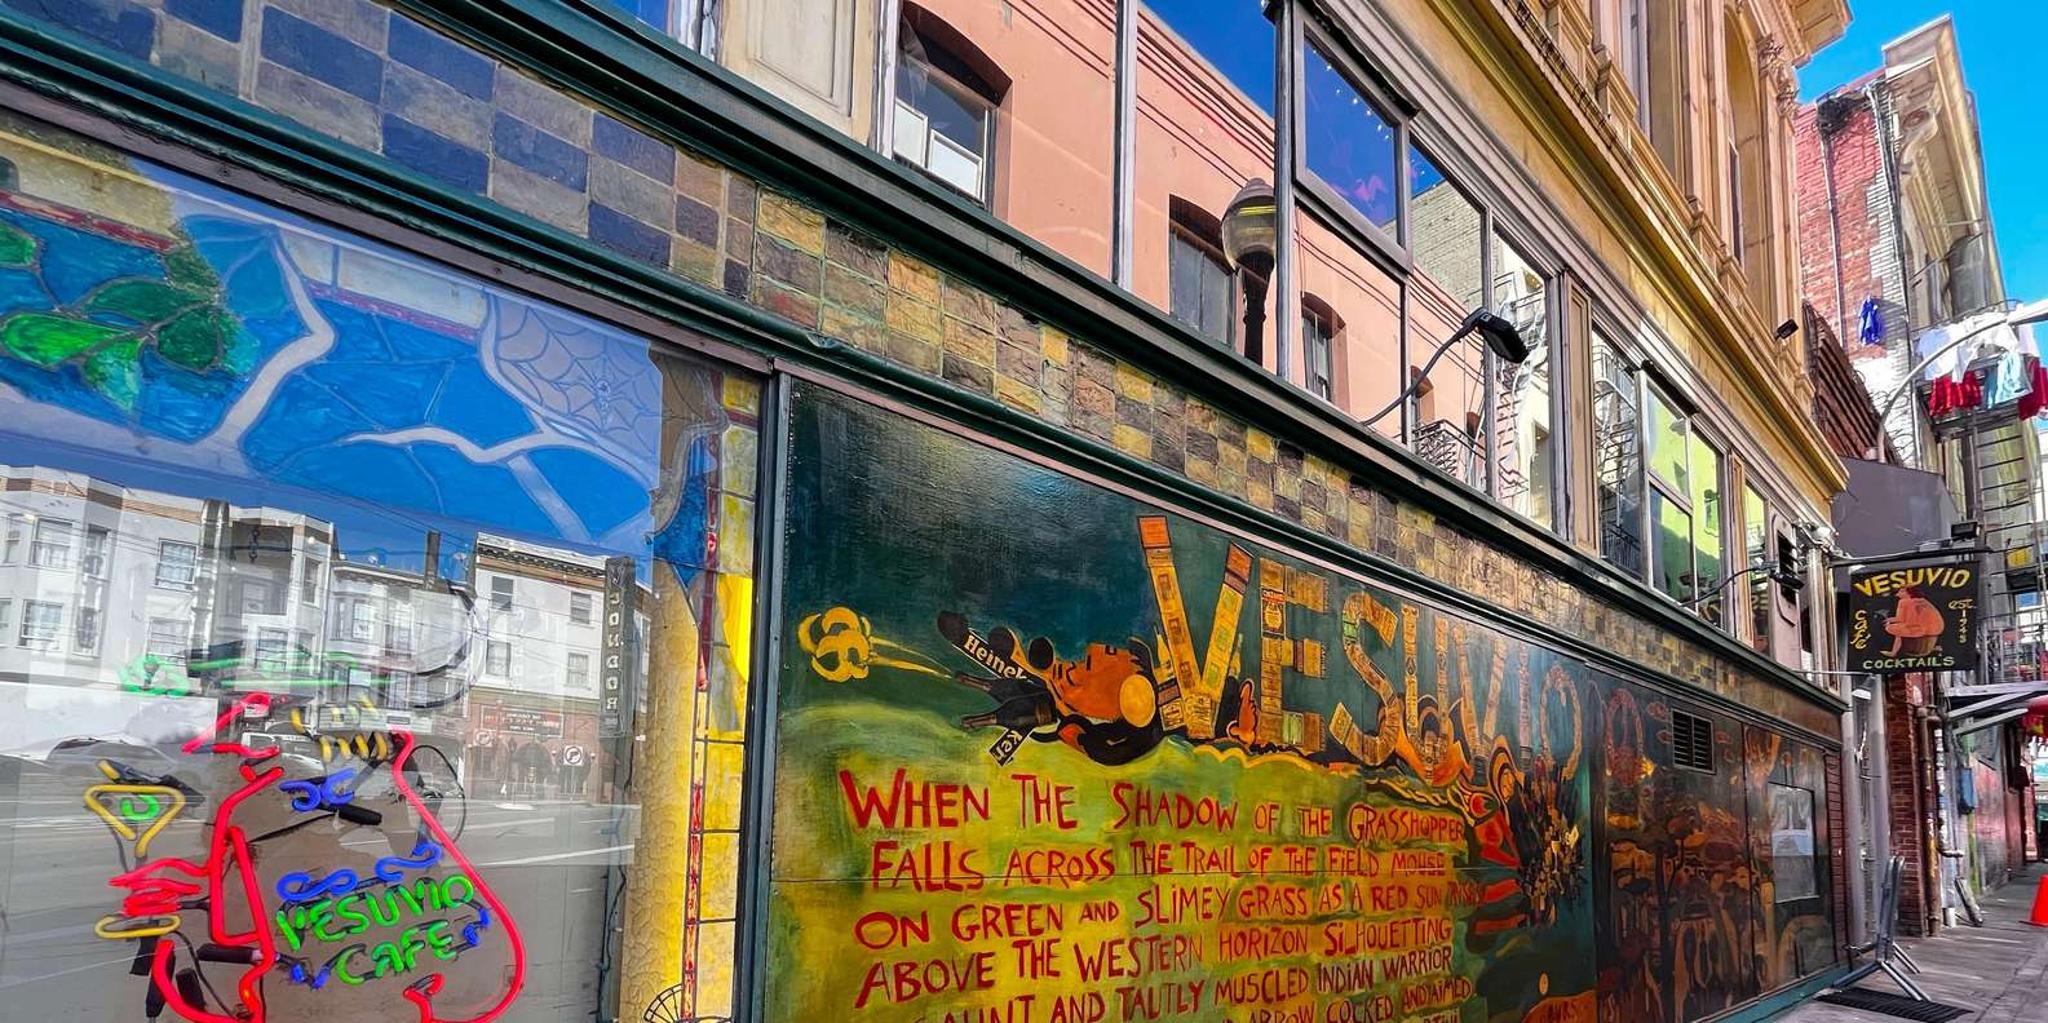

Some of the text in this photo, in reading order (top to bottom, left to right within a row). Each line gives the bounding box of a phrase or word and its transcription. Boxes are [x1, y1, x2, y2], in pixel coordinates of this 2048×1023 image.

[1854, 567, 1971, 597] VESUVIO
[1862, 656, 1955, 670] COCKTAILS
[839, 768, 1464, 843] WHEN THE SHADOW OF THE GRASSHOPPER
[872, 840, 984, 892] FALLS
[1004, 847, 1116, 888] ACROSS
[1130, 840, 1173, 877] THE
[1180, 841, 1242, 878] TRAIL
[1248, 848, 1273, 877] OF
[1284, 848, 1317, 876] THE
[1391, 852, 1447, 877] MOUSE
[275, 874, 474, 951] VESUVIO
[854, 911, 930, 949] ON
[952, 904, 1063, 941] GREEN
[1079, 901, 1119, 923] AND
[1238, 885, 1307, 918] GRASS
[1319, 884, 1342, 912] AS
[1352, 882, 1363, 911] A
[1371, 886, 1408, 911] RED
[1416, 884, 1440, 909] SUN
[335, 919, 457, 986] CAFE
[855, 952, 996, 1008] ABOVE
[1012, 938, 1061, 979] THE
[1074, 934, 1203, 983] WESTERN
[1219, 926, 1308, 962] HORIZON
[1050, 992, 1106, 1023] AND
[1115, 979, 1204, 1023] TAUTLY
[1214, 968, 1309, 1006] MUSCLED
[1326, 995, 1394, 1023] COCKED
